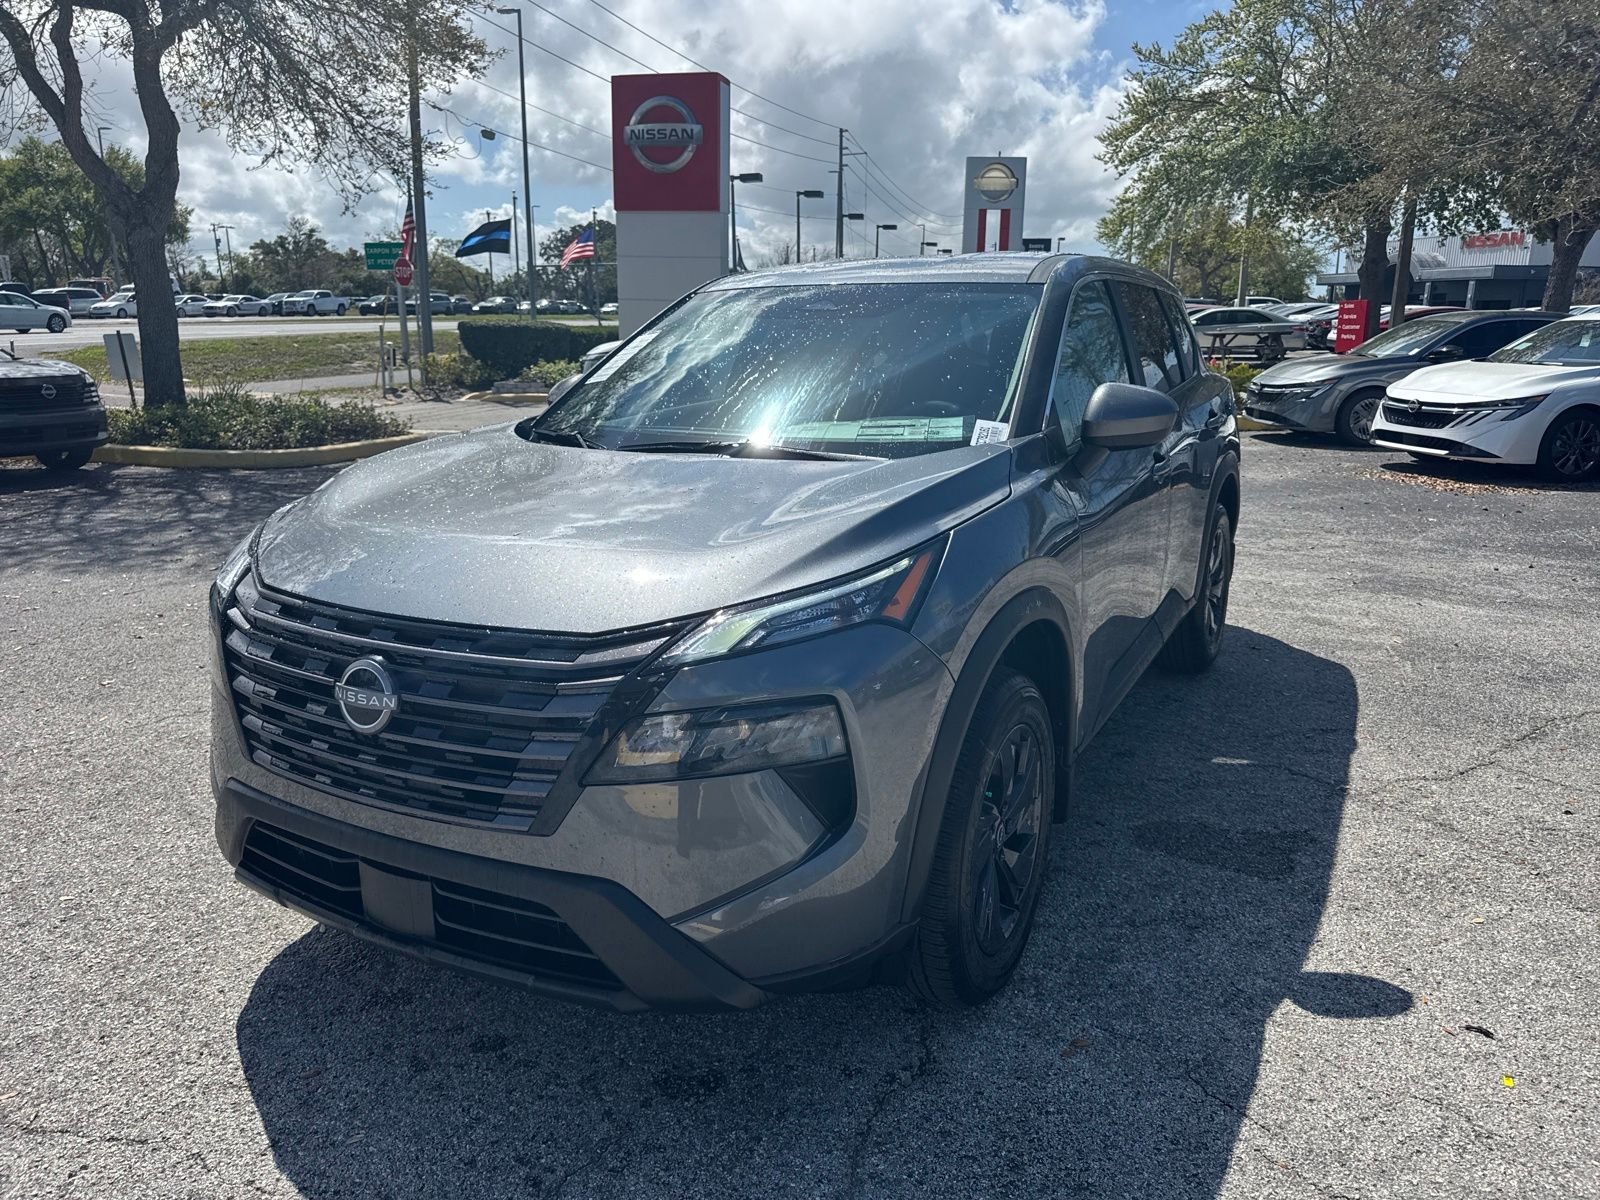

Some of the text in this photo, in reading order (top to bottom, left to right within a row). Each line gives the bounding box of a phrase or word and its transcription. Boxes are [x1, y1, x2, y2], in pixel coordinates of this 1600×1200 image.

[630, 128, 694, 140] NISSAN
[366, 247, 390, 255] TARPON
[395, 266, 412, 278] STOP
[335, 686, 395, 708] NISSAN
